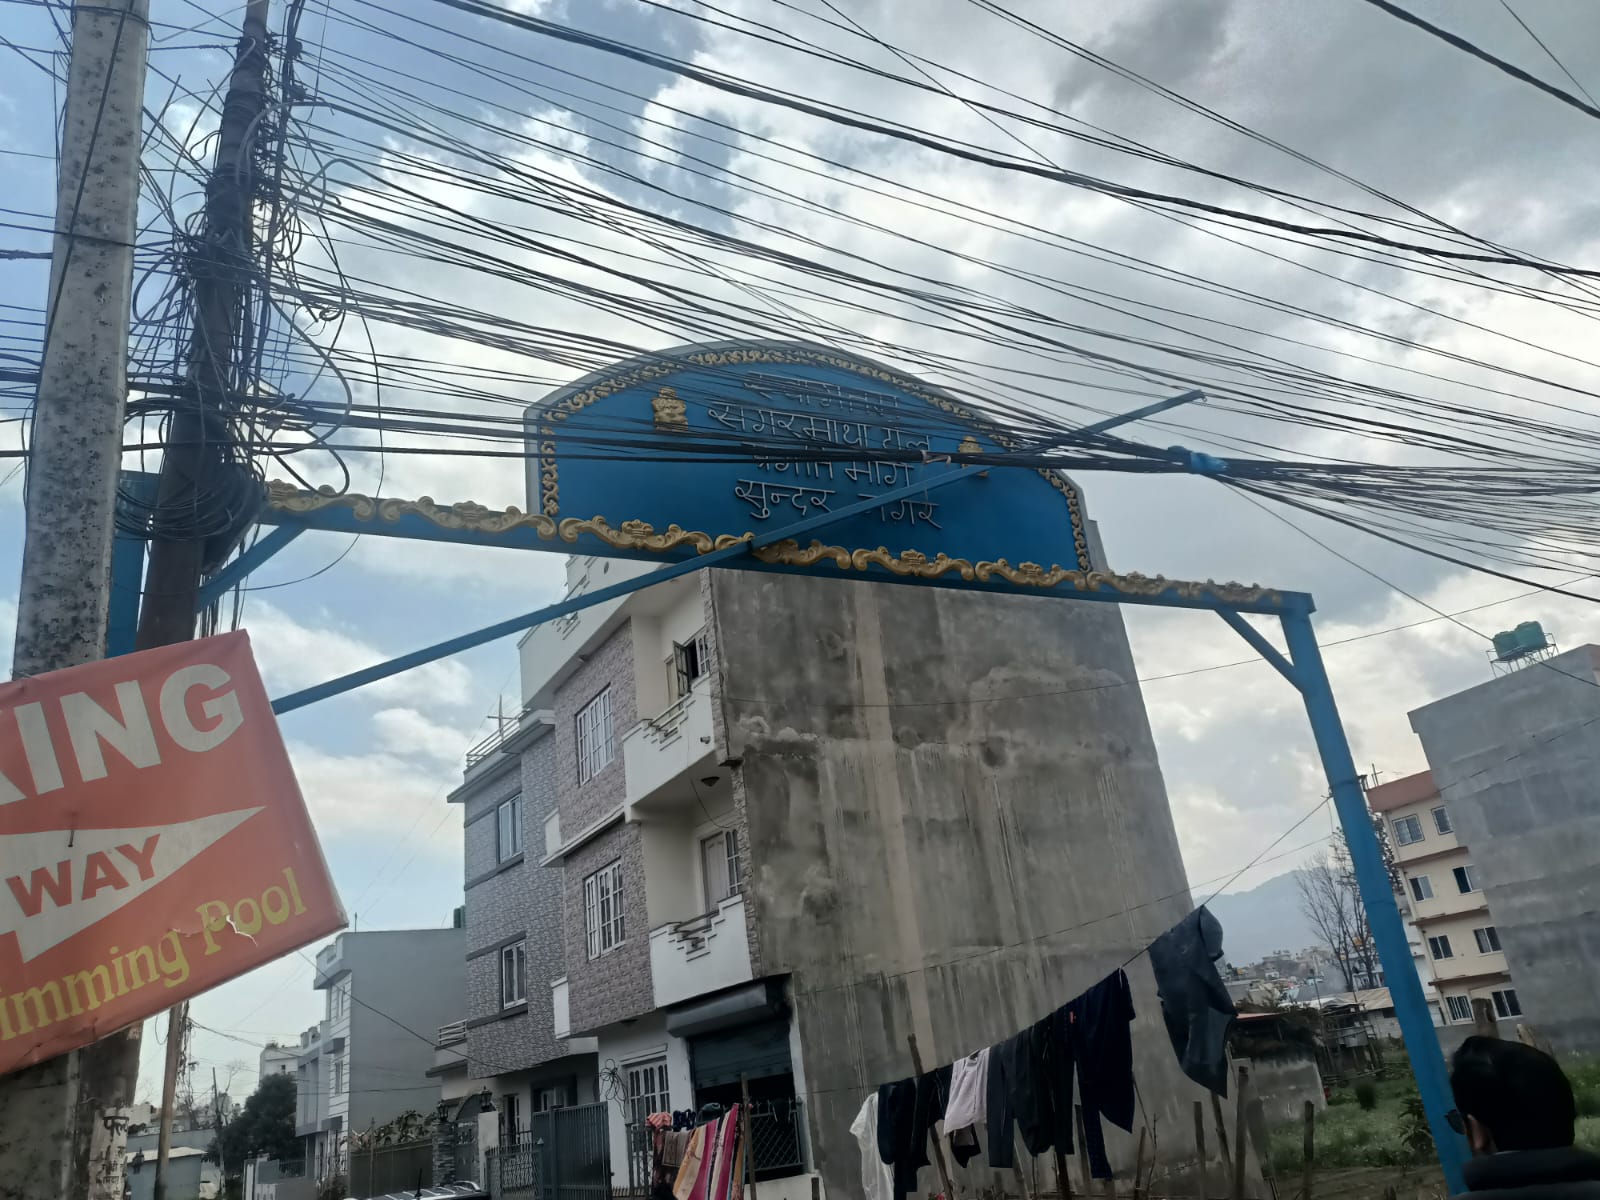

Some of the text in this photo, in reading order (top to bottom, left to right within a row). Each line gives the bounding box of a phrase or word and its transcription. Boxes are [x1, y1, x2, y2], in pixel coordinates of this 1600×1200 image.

[734, 478, 837, 518] सुन्दर
[5, 833, 161, 918] WAY
[195, 866, 307, 956] Pool
